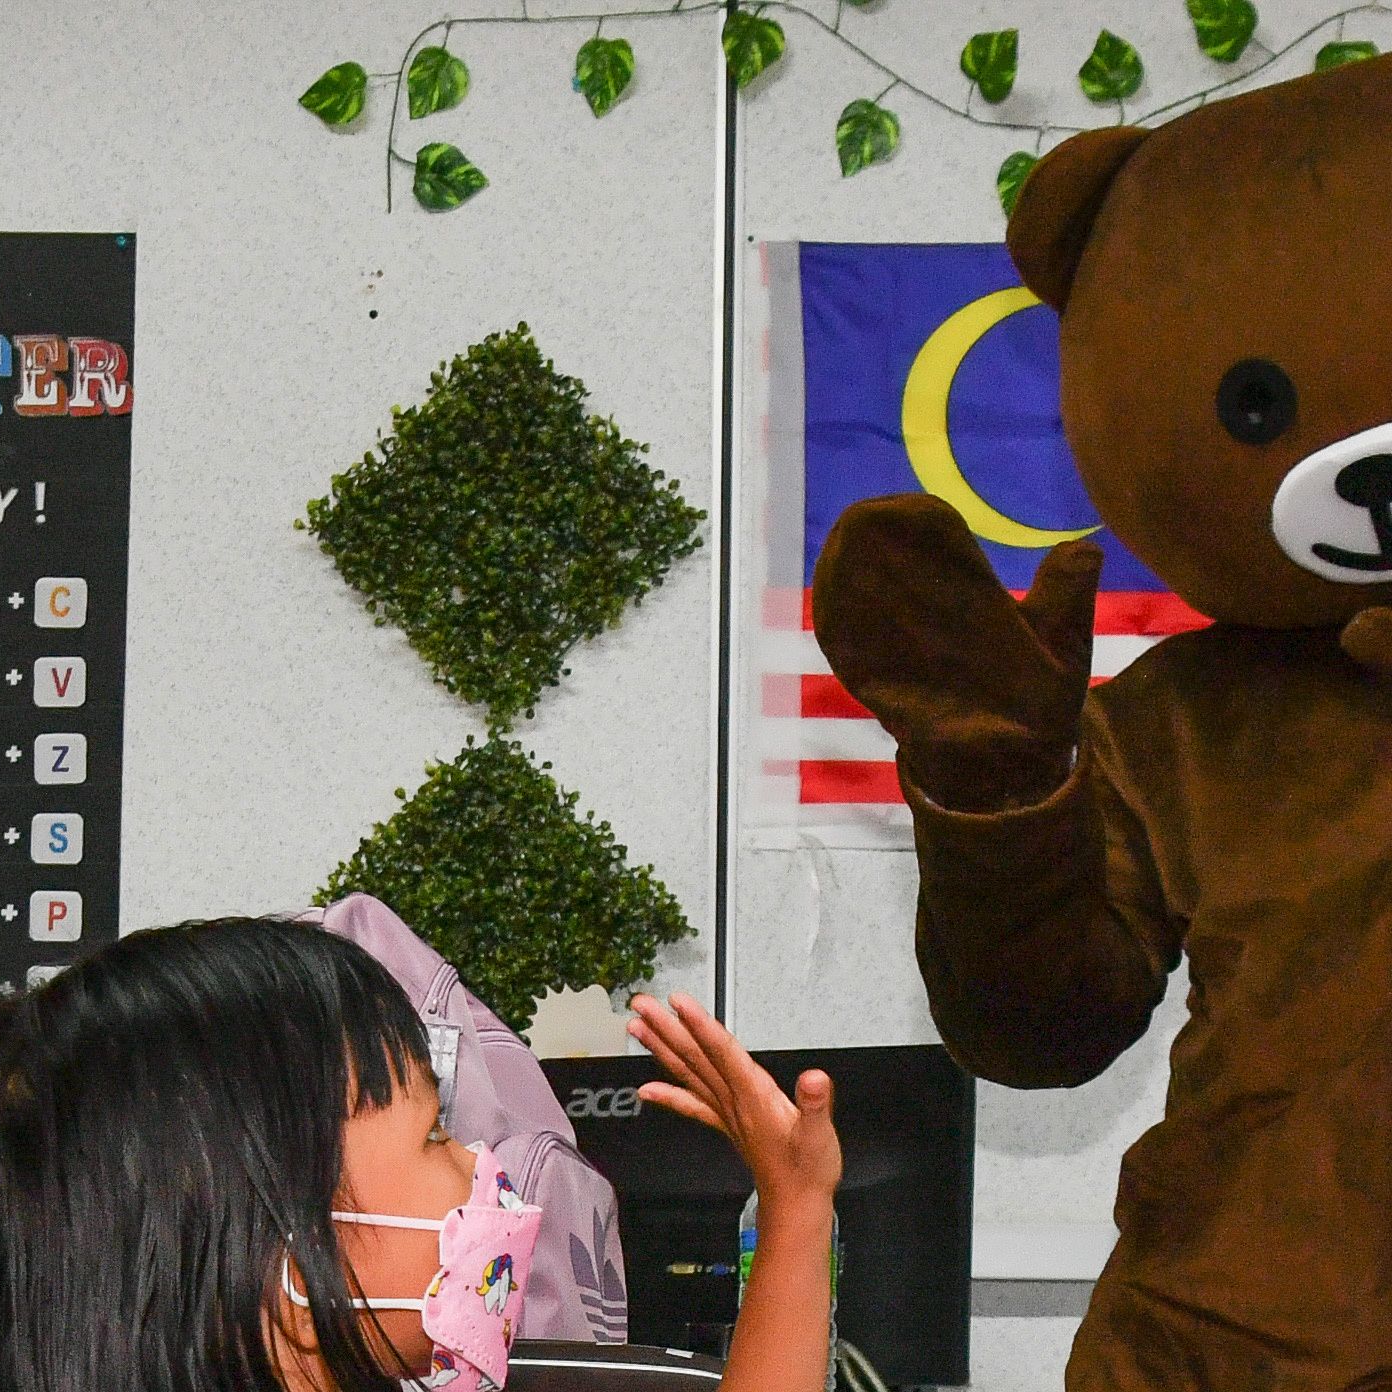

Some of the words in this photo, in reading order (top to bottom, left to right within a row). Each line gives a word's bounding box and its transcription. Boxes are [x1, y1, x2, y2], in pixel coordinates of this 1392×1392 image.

[8, 591, 25, 610] +
[49, 586, 71, 618] C
[5, 668, 23, 686] +
[51, 667, 73, 698] V
[5, 745, 22, 763] +
[51, 745, 70, 773] Z
[3, 827, 21, 845] +
[48, 822, 69, 854] S
[48, 901, 68, 932] P
